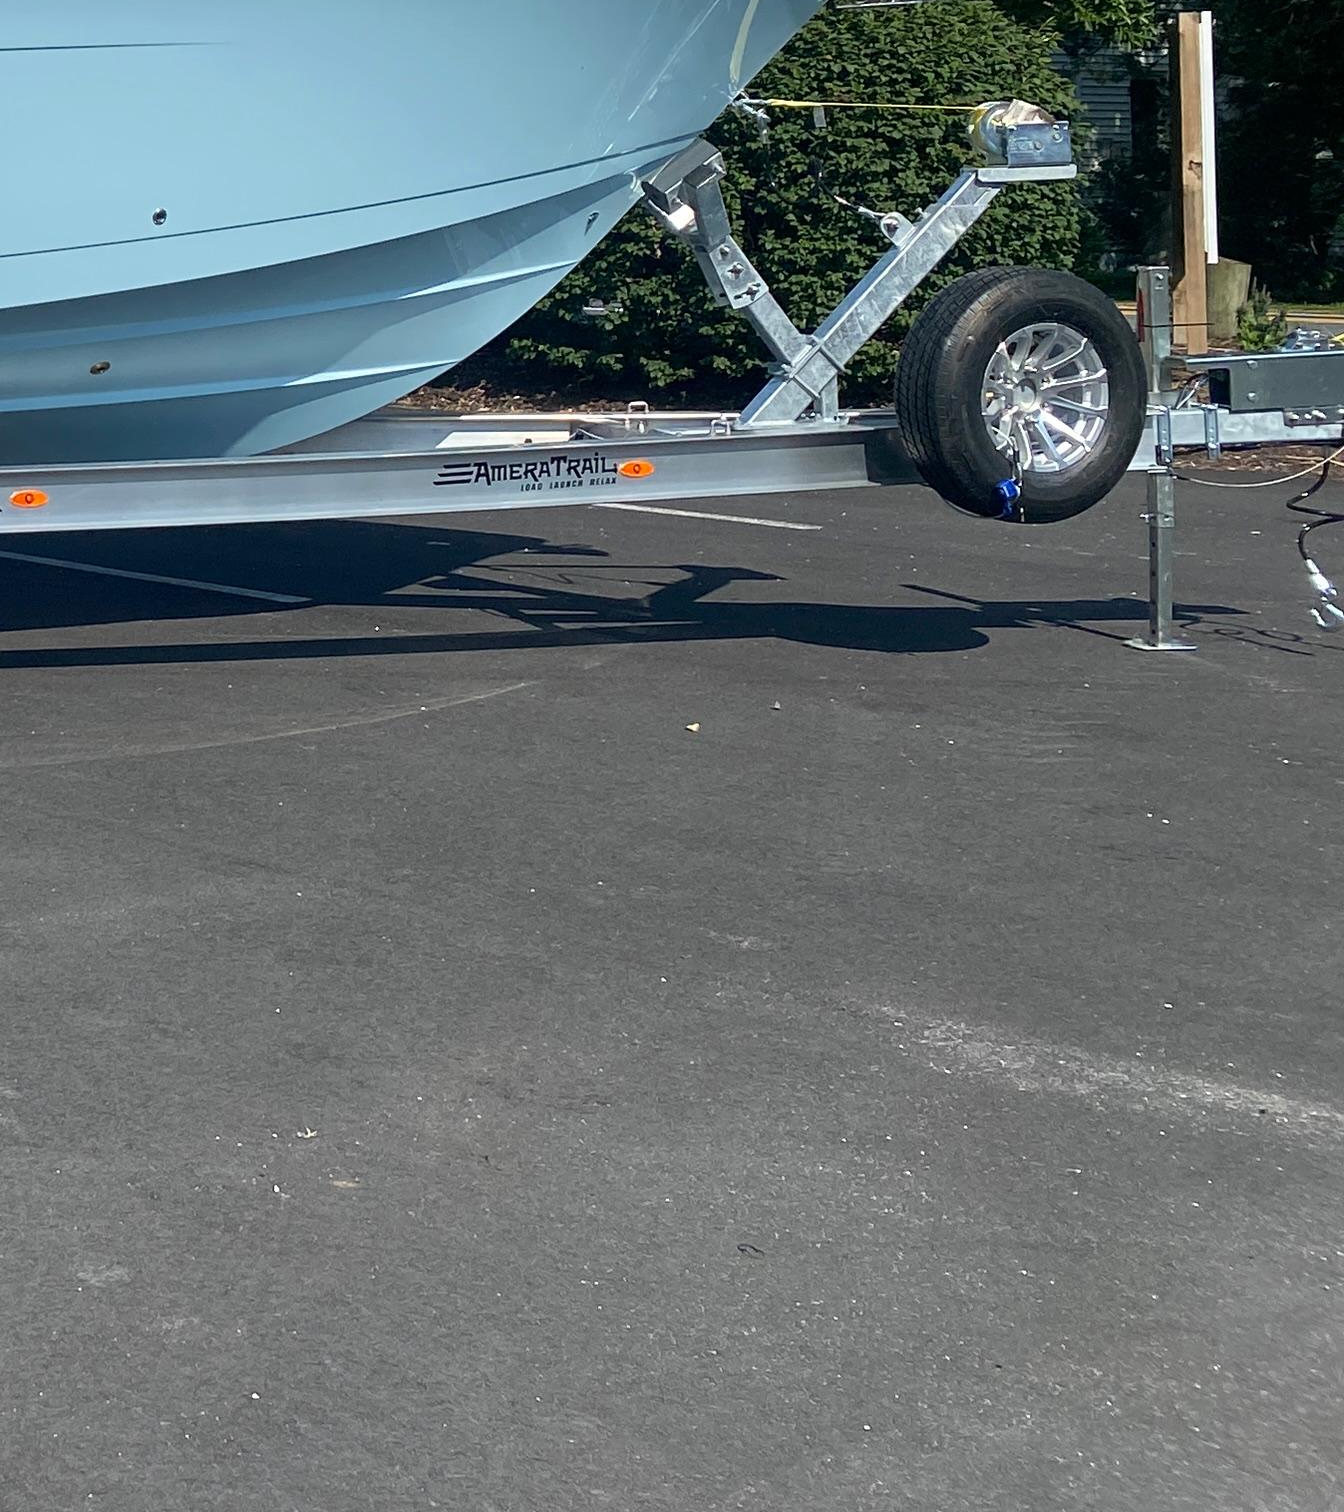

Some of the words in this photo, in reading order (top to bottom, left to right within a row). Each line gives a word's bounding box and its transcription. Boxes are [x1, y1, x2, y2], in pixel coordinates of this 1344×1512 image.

[520, 483, 543, 492] LOAD
[550, 479, 584, 489] LAUNCH
[589, 477, 617, 486] RELAX
